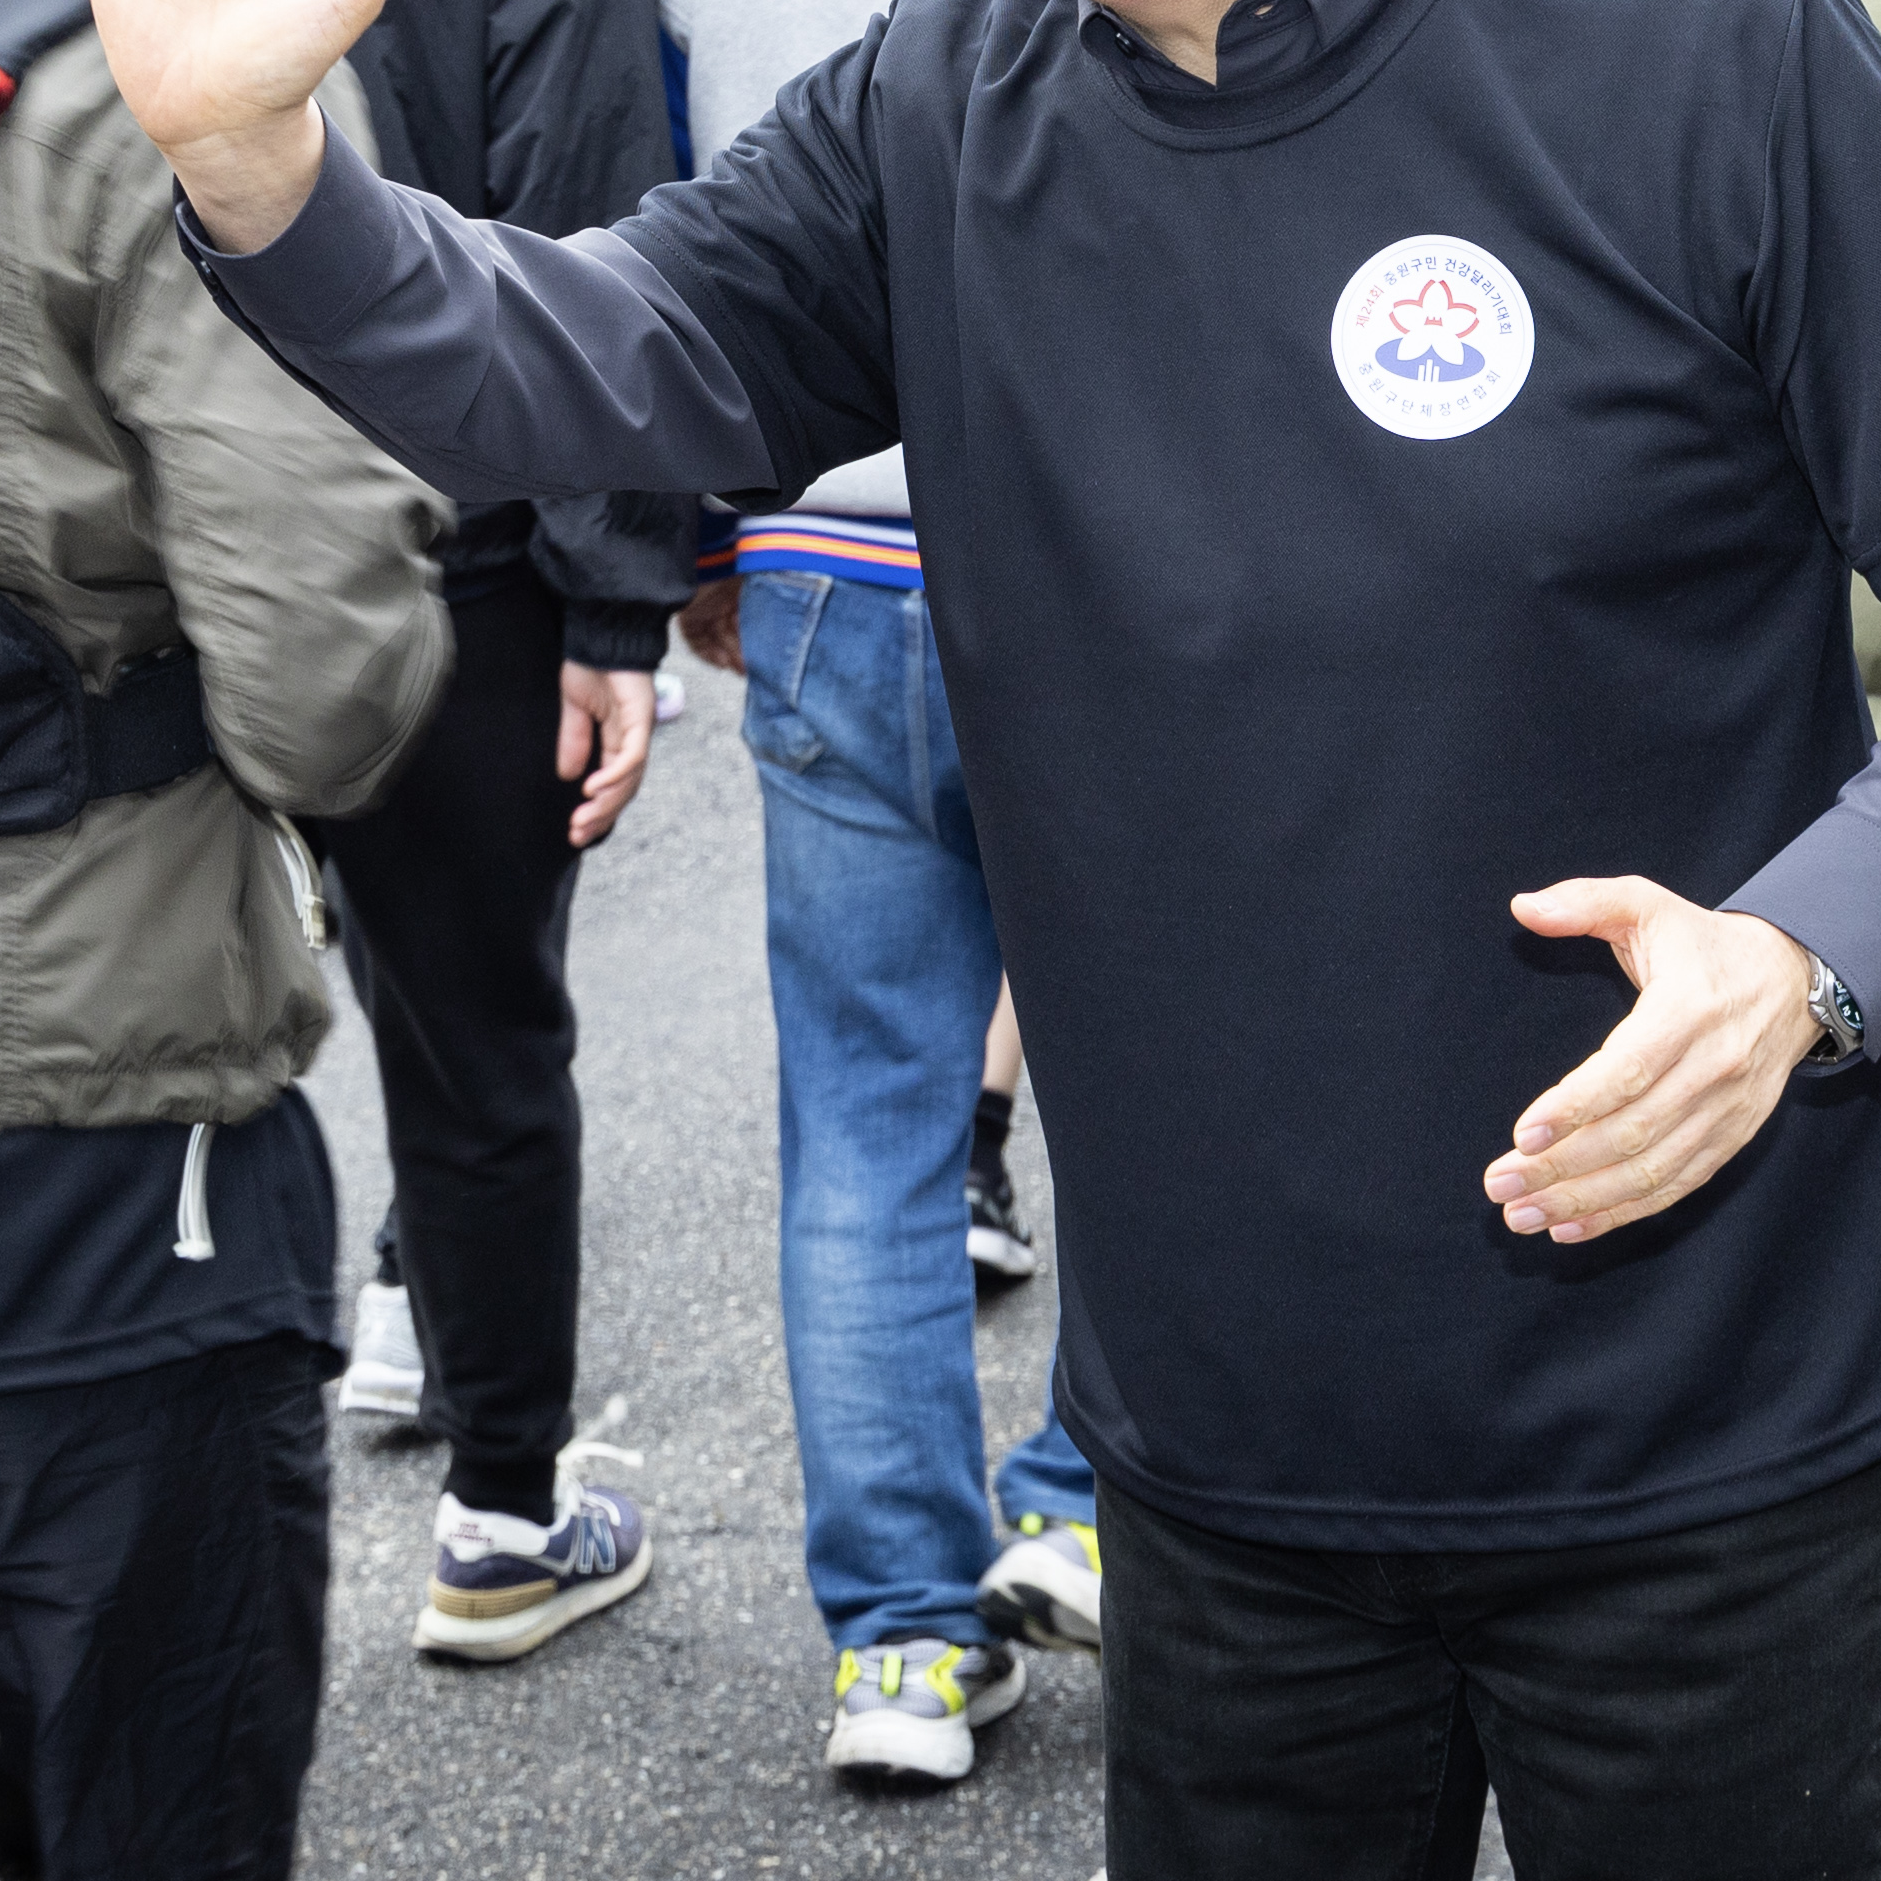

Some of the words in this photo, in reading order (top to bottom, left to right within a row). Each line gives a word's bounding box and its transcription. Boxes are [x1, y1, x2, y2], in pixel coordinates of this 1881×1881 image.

[1356, 285, 1385, 328] 제24회
[1383, 256, 1437, 286] 중원구민
[1445, 258, 1513, 334] 건강달리기대회
